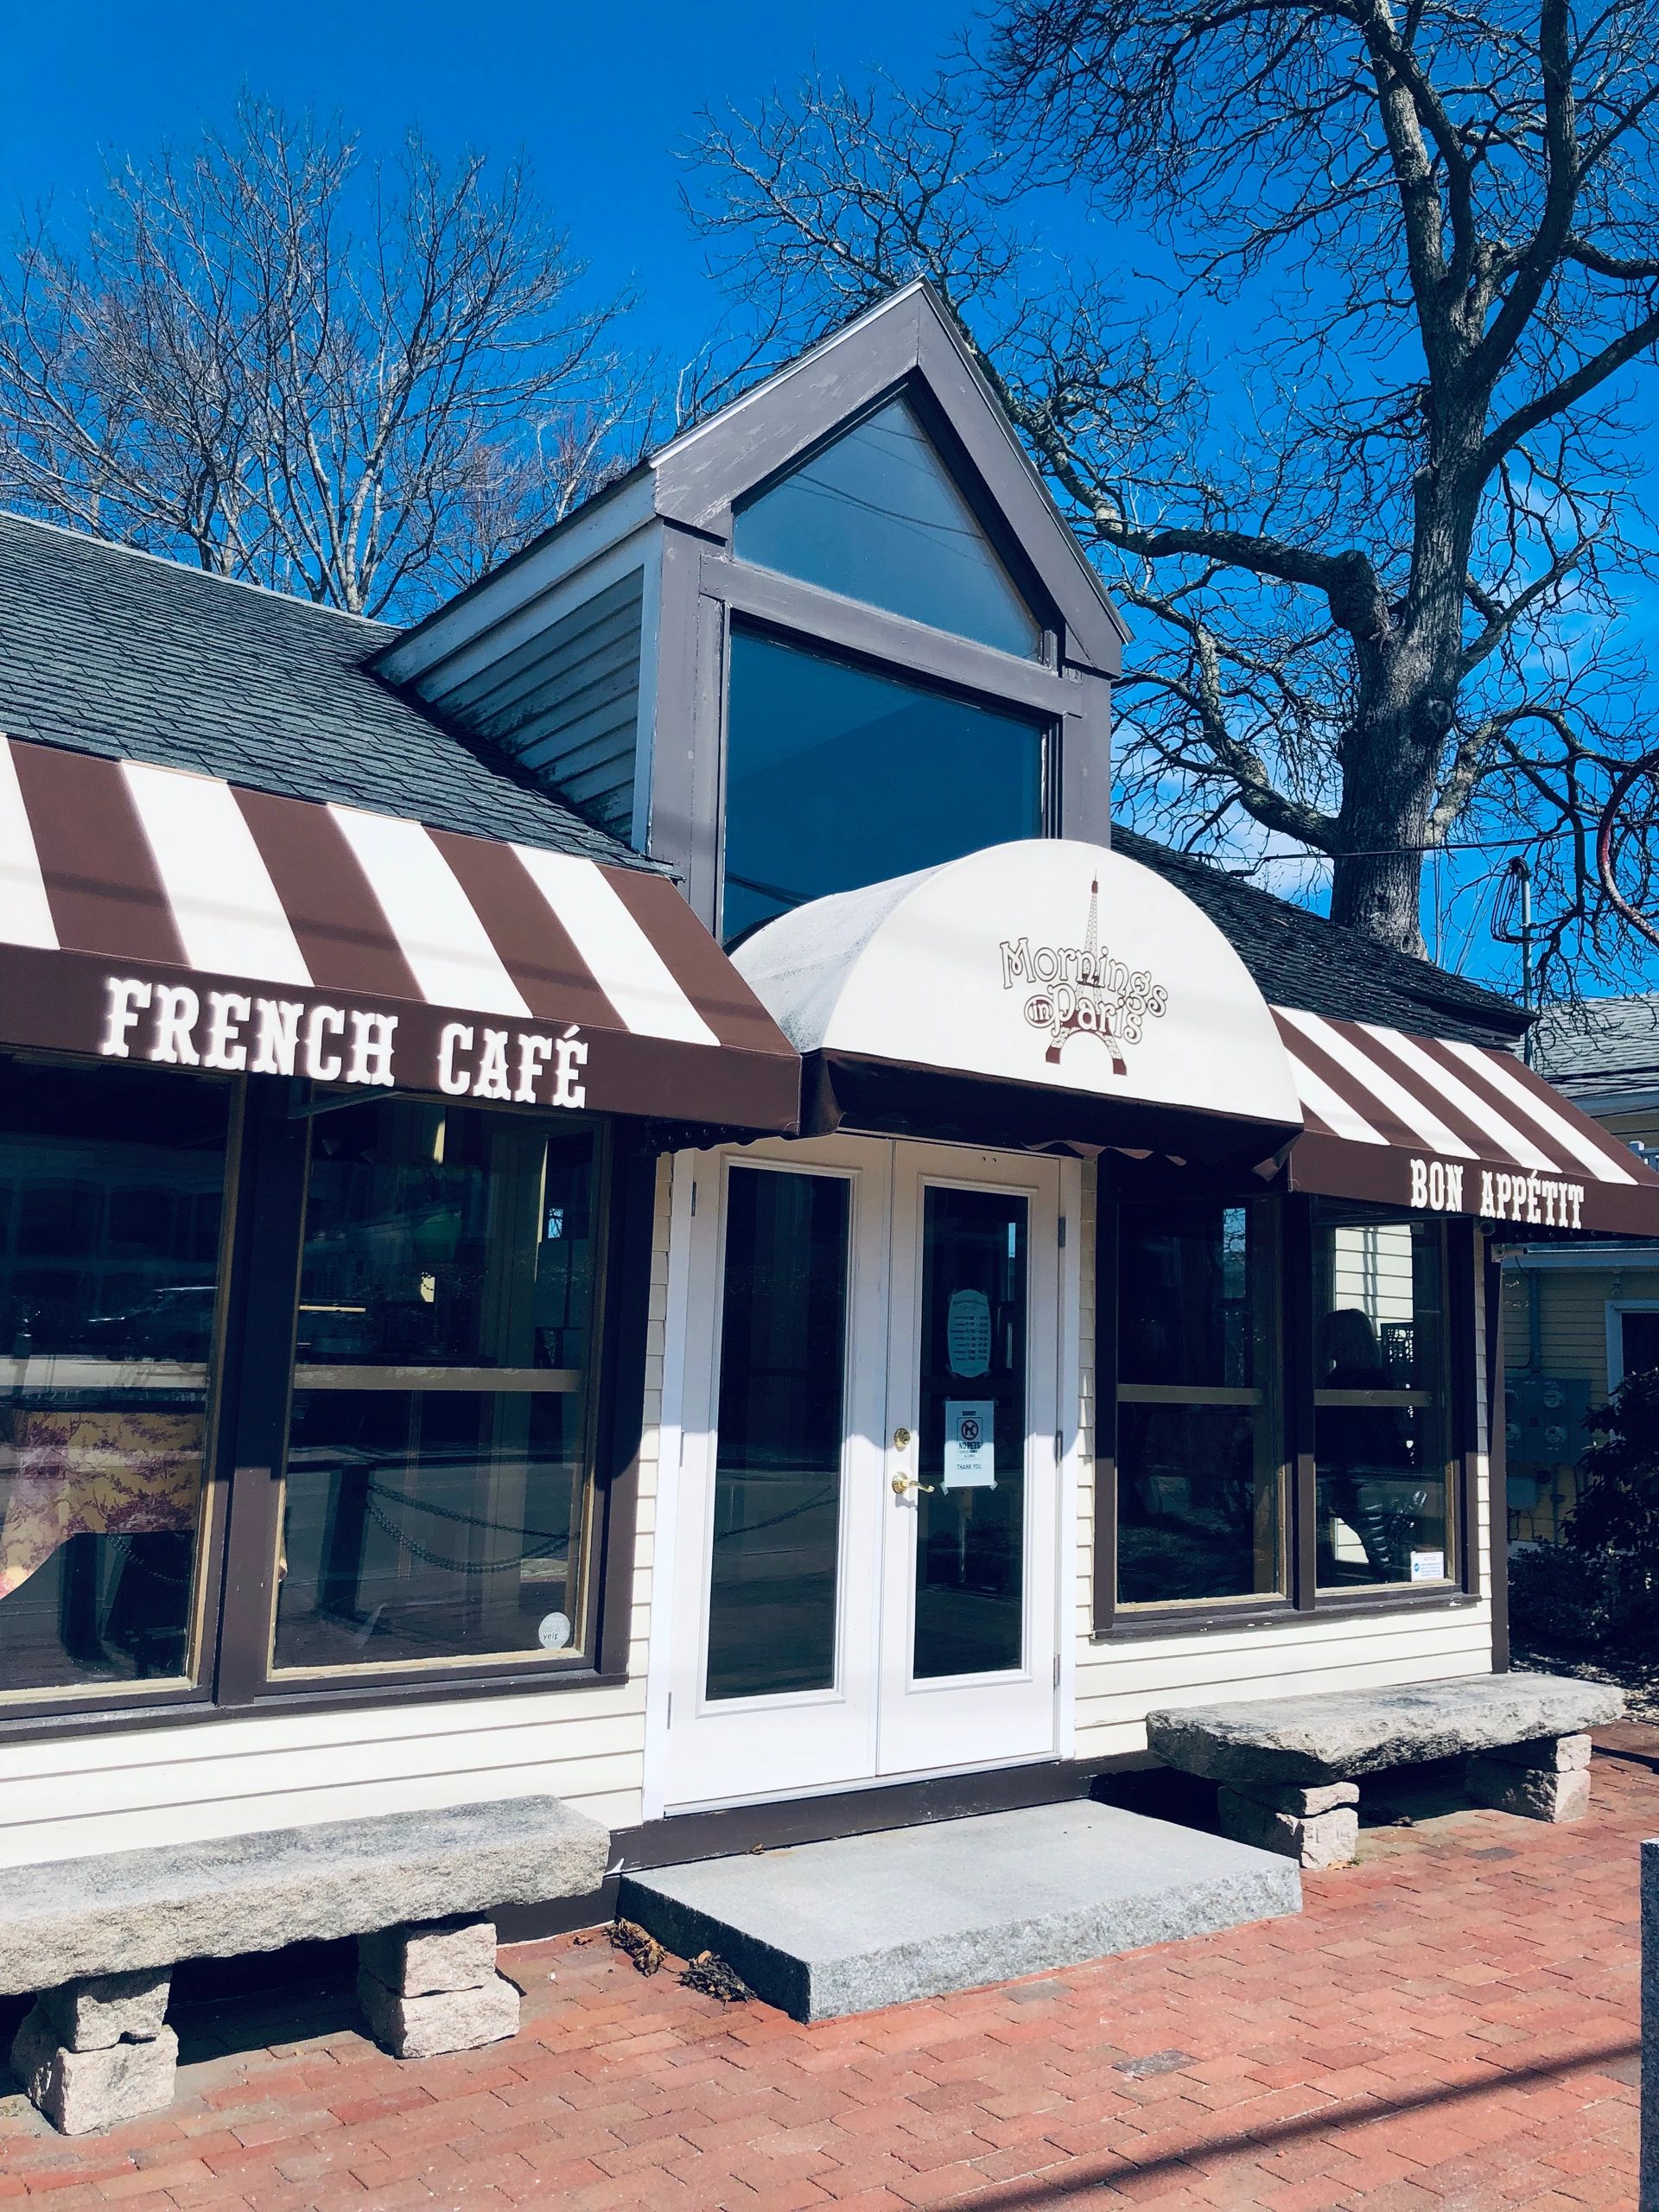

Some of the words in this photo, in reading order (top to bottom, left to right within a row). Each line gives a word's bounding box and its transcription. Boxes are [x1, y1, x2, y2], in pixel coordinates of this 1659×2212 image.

[1000, 938, 1168, 1018] Mornings
[102, 976, 398, 1088] FRENCH
[436, 1024, 589, 1109] CAFÉ
[1047, 983, 1142, 1045] Paris
[1410, 1158, 1464, 1213] BON
[1479, 1168, 1585, 1230] APPÉTIT
[967, 1441, 981, 1450] PETS
[543, 1631, 559, 1642] yelp
